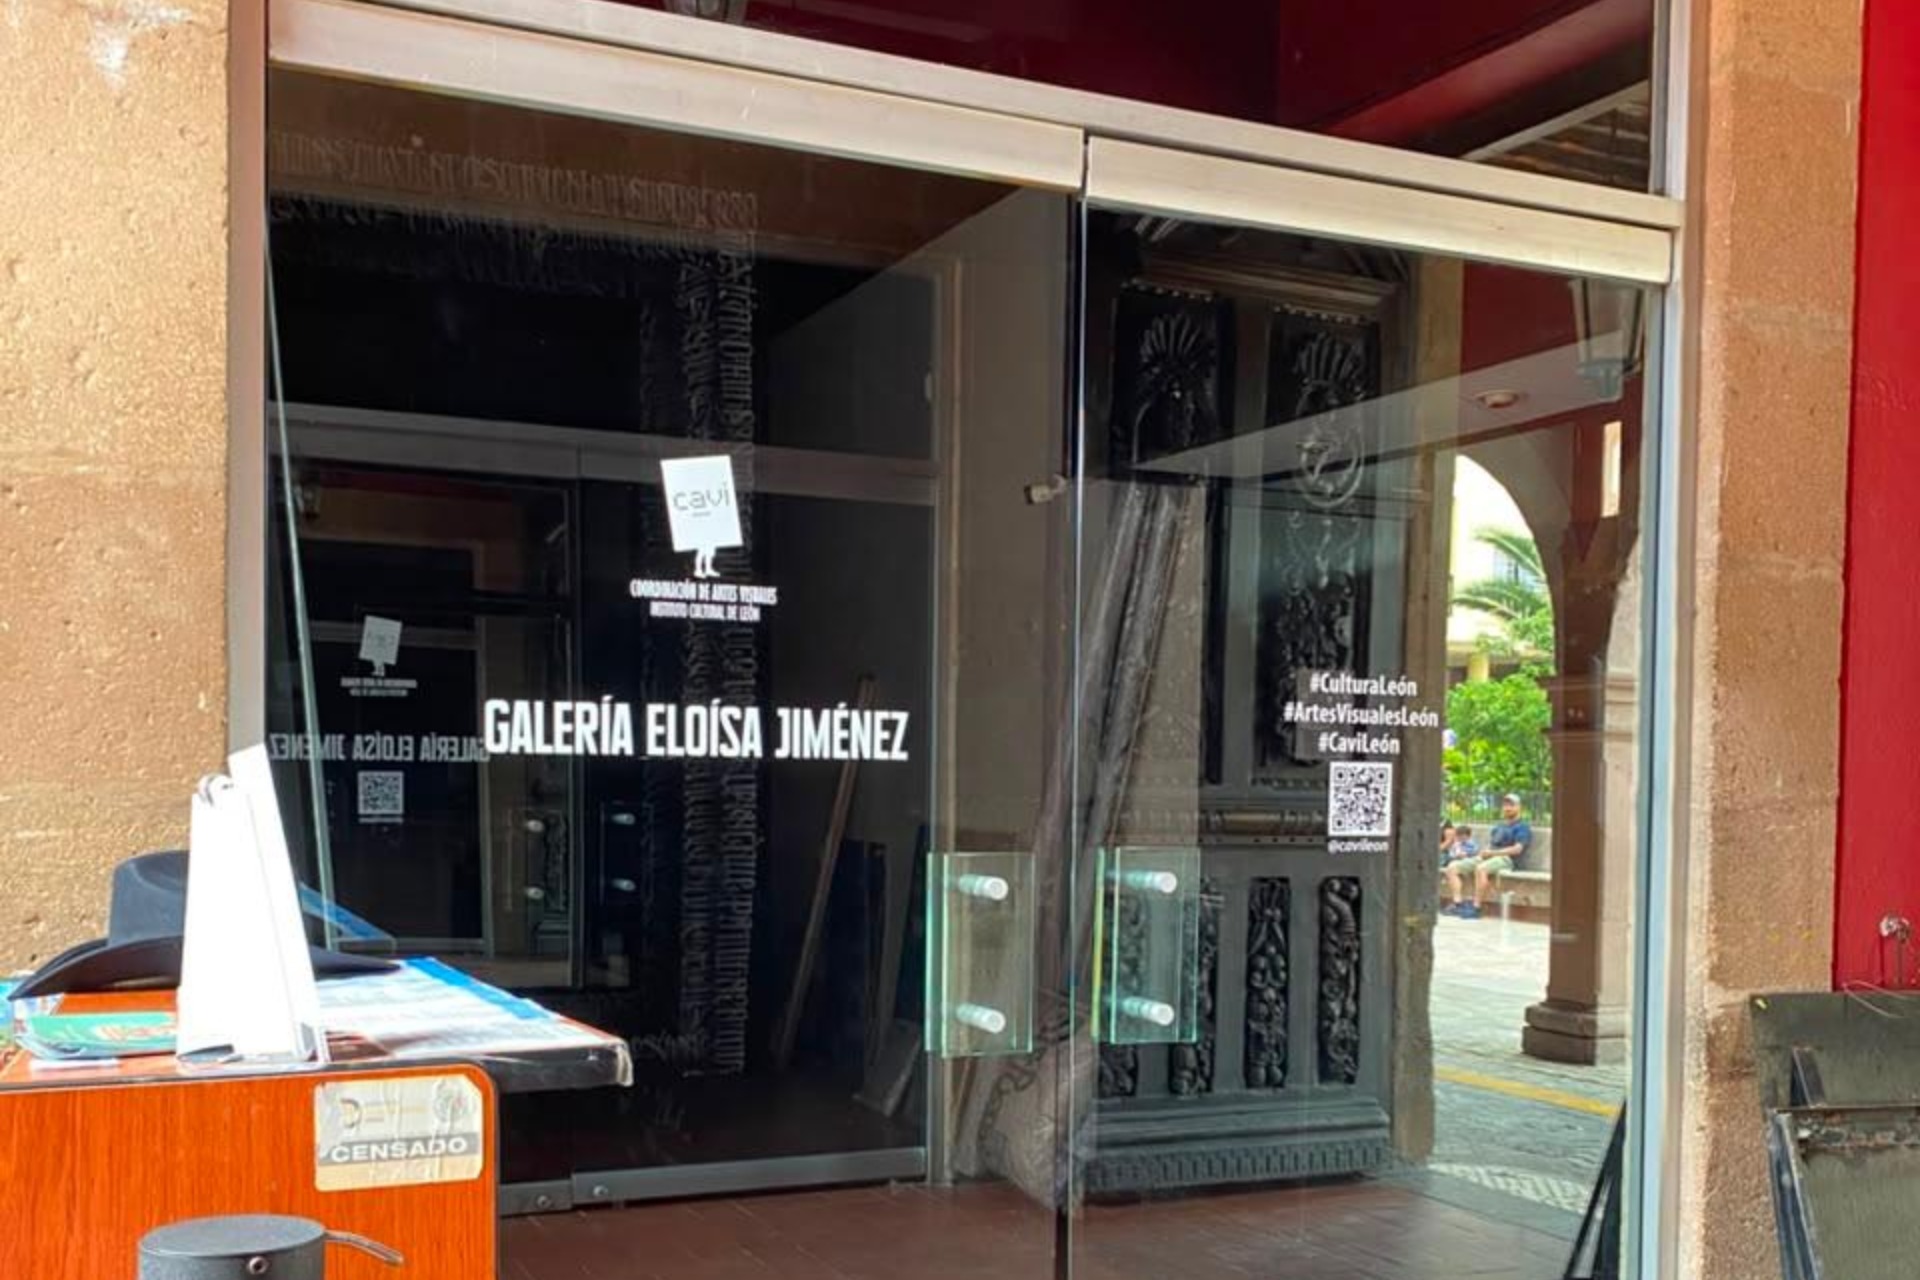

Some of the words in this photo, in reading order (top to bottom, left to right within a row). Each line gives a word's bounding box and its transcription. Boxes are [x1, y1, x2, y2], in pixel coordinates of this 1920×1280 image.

[673, 481, 730, 511] cavi
[1310, 673, 1418, 697] #CulturaLeón
[1283, 701, 1440, 727] #ArtesVisualesLeón
[484, 694, 634, 756] GALERÍA
[645, 698, 763, 759] ELOÍSA
[774, 702, 910, 762] JIMÉNEZ
[1318, 732, 1401, 755] #CaviLeón
[331, 1137, 468, 1163] CENSADO
